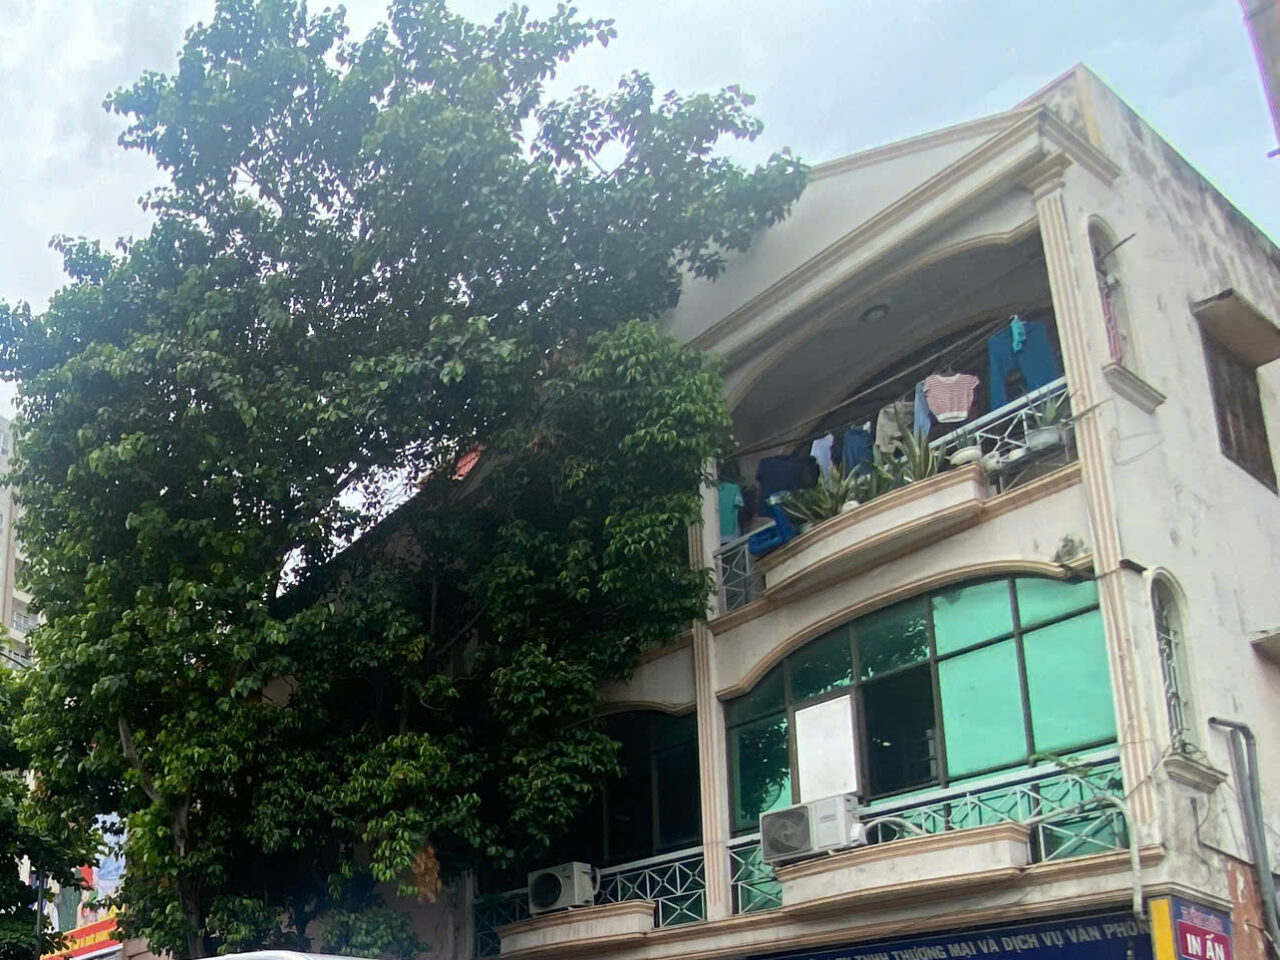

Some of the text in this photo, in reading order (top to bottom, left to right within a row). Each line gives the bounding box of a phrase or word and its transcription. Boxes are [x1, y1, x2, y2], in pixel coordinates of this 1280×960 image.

[949, 942, 977, 960] MẠI
[977, 935, 1000, 953] VÀ
[1005, 932, 1039, 952] DỊCH
[1040, 929, 1064, 949] VỤ
[1186, 932, 1202, 957] IN
